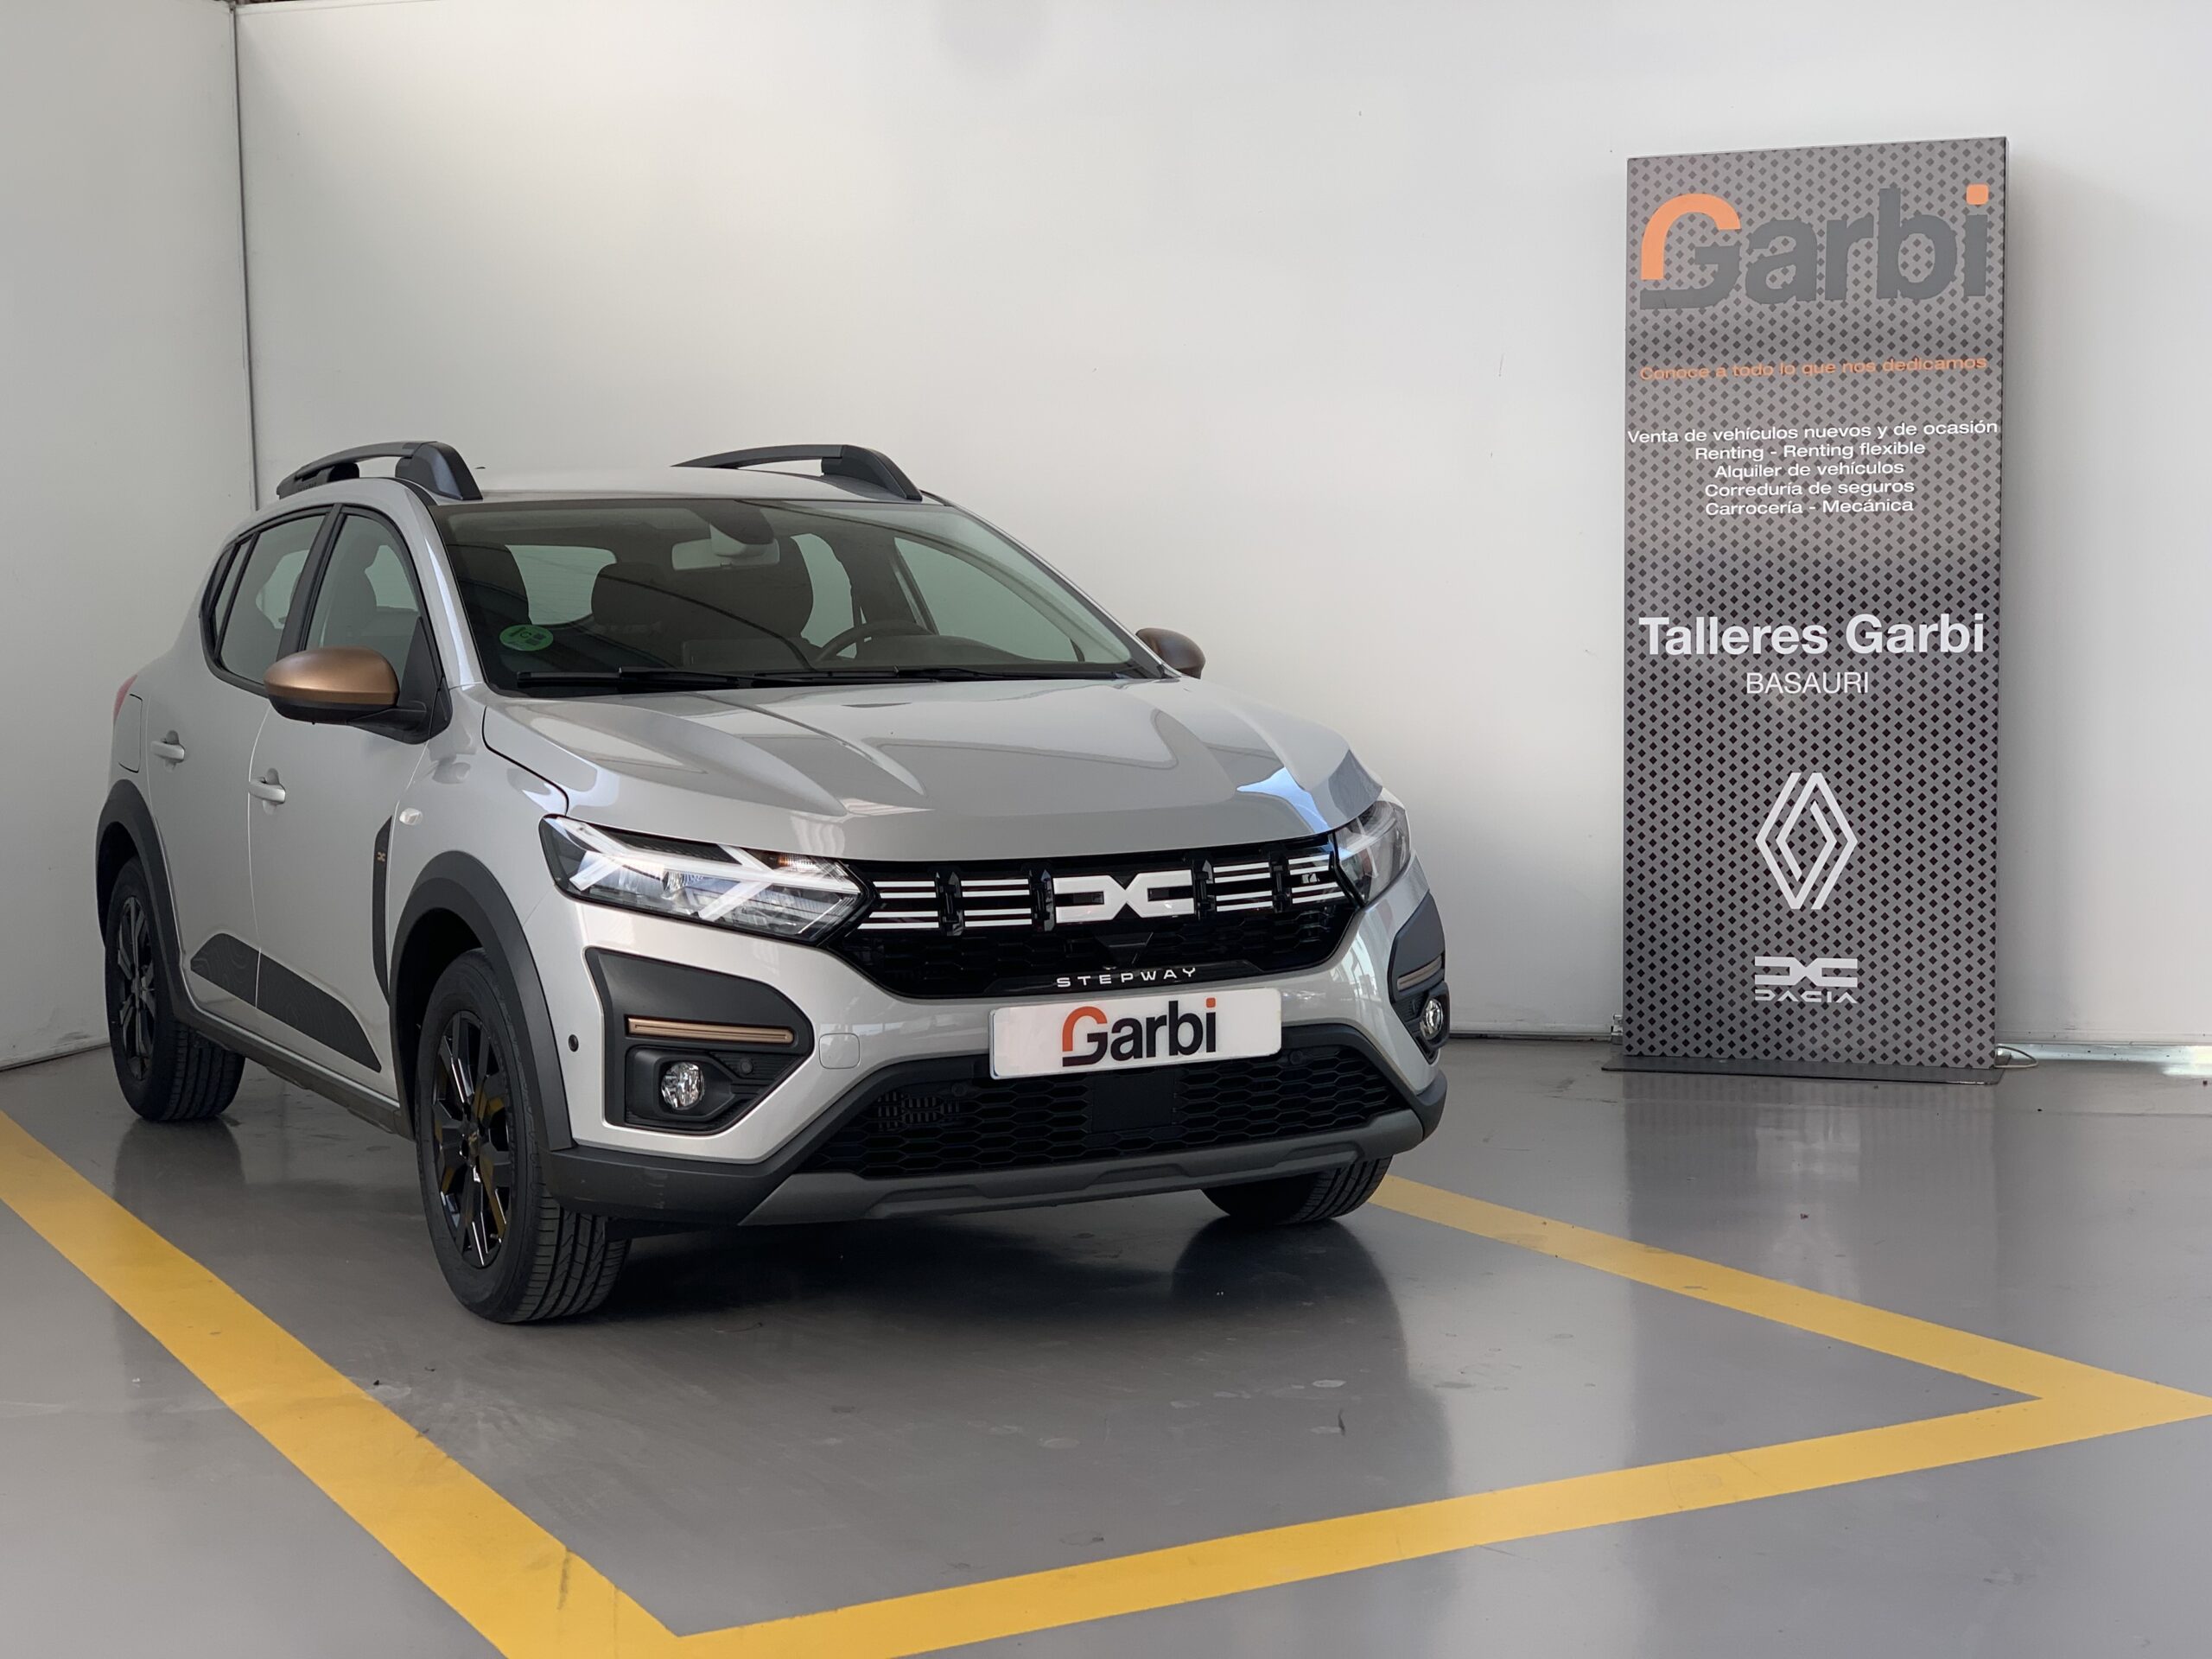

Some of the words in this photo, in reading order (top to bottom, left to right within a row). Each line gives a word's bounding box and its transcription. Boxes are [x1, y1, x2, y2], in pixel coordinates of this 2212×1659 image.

[1640, 183, 1989, 310] Garbi
[1640, 365, 1709, 380] Conoce
[1716, 367, 1727, 378] a
[1732, 363, 1774, 377] todo
[1780, 361, 1796, 376] lo
[1802, 362, 1836, 376] que
[1842, 360, 1877, 373] nos
[1882, 357, 1987, 372] dedicamos
[1627, 430, 1680, 444] Venta
[1684, 429, 1707, 442] de
[1713, 426, 1798, 442] vehículos
[1804, 425, 1872, 439] nuevos
[1877, 424, 1888, 438] y
[1892, 421, 1917, 436] de
[1923, 420, 1998, 435] ocasión
[1695, 445, 1764, 462] Renting
[1783, 443, 1854, 460] Renting
[1859, 442, 1926, 456] flexible
[1714, 464, 1783, 480] Alquiler
[1788, 464, 1811, 477] de
[1817, 461, 1904, 476] vehículos
[1705, 481, 1803, 497] Correduría
[1808, 480, 1832, 494] de
[1838, 480, 1915, 497] seguros
[1705, 500, 1803, 516] Carrocería
[1822, 499, 1914, 514] Mecánica
[1638, 616, 1829, 655] Talleres
[1846, 613, 1985, 654] Garbi
[1746, 671, 1869, 694] BASAURI
[1056, 967, 1196, 988] STEPWAY
[1754, 988, 1859, 1004] DACIA
[1061, 997, 1217, 1067] Garbi
